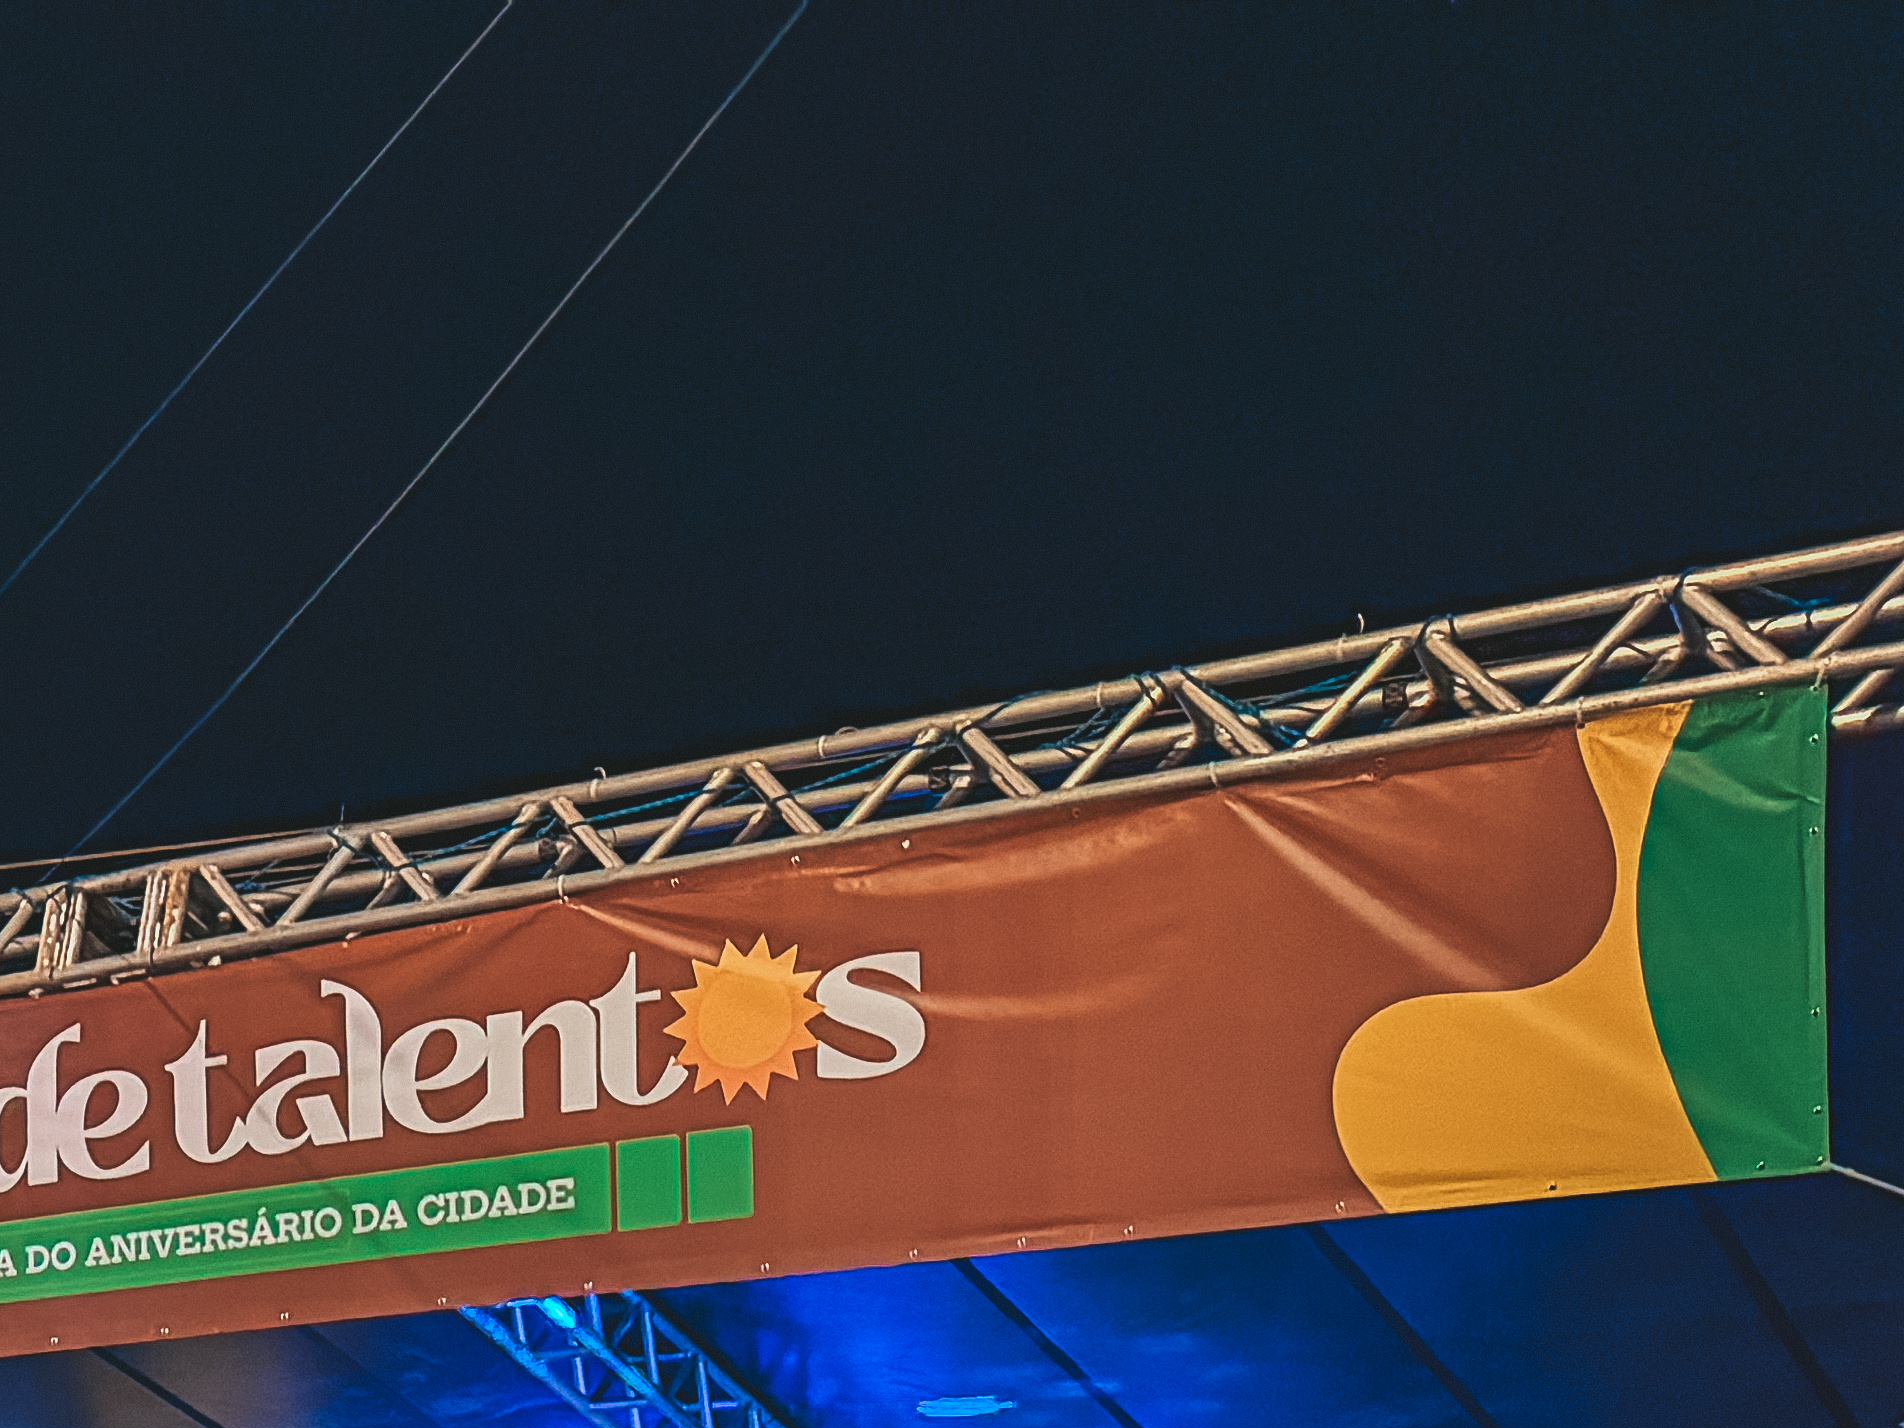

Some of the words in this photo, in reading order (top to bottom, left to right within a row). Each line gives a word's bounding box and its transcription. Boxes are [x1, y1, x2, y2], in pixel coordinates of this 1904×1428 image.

[25, 1241, 77, 1275] DO
[84, 1206, 343, 1268] ANIVERSÁRIO
[352, 1200, 408, 1235] DA
[417, 1177, 576, 1227] CIDADE
